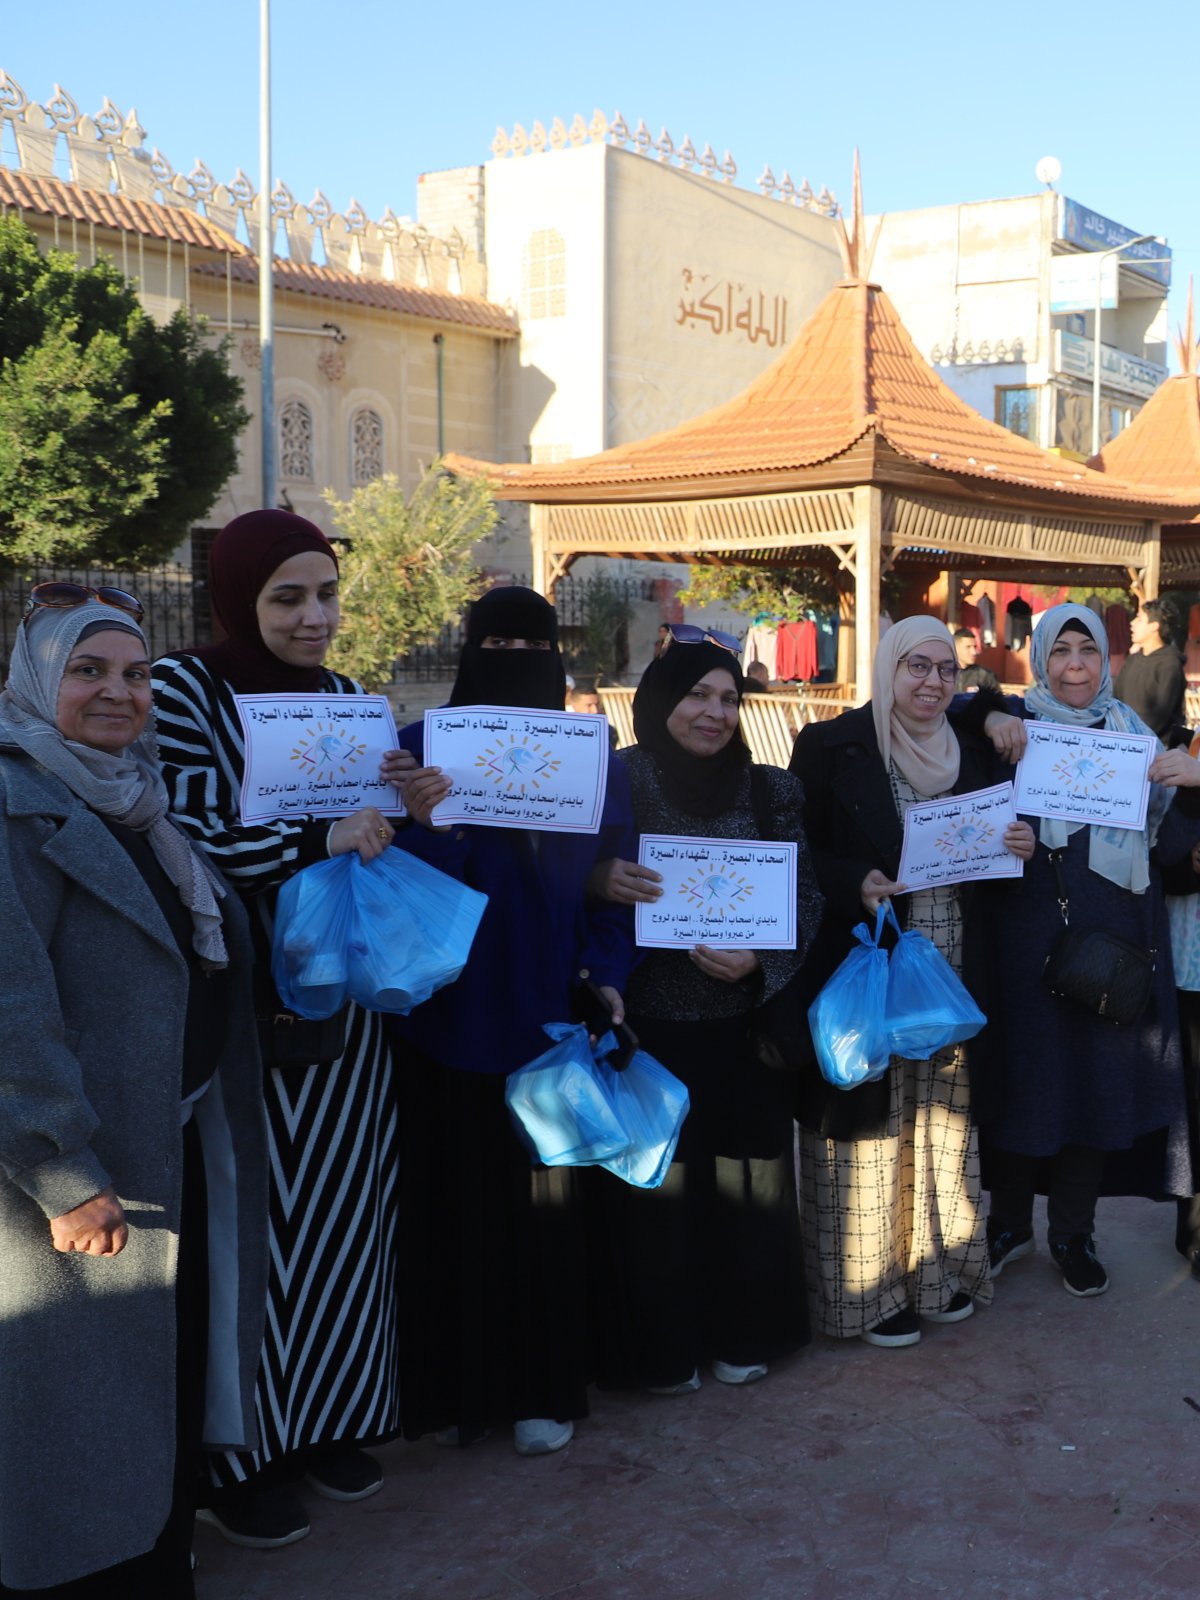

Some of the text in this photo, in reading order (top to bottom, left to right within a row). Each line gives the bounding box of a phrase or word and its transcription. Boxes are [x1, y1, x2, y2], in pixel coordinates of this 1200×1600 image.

[736, 290, 788, 348] الله
[250, 708, 280, 724] السيرة
[283, 705, 313, 721] لشهداء
[325, 707, 357, 723] البصيرة
[437, 719, 470, 733] السيرة
[473, 717, 508, 733] لشهداء
[524, 721, 562, 737] البصيرة
[564, 724, 598, 739] أصحاب
[1031, 730, 1054, 744] السيرة
[447, 787, 462, 798] لرو
[496, 790, 528, 802] البصيرة
[464, 803, 491, 815] السيرة
[650, 846, 679, 862] السيرة
[680, 848, 710, 862] لشهداء
[723, 851, 755, 866] البصيرة
[757, 852, 787, 866] أصحاب
[652, 913, 670, 924] لروح
[700, 914, 727, 926] البصيرة
